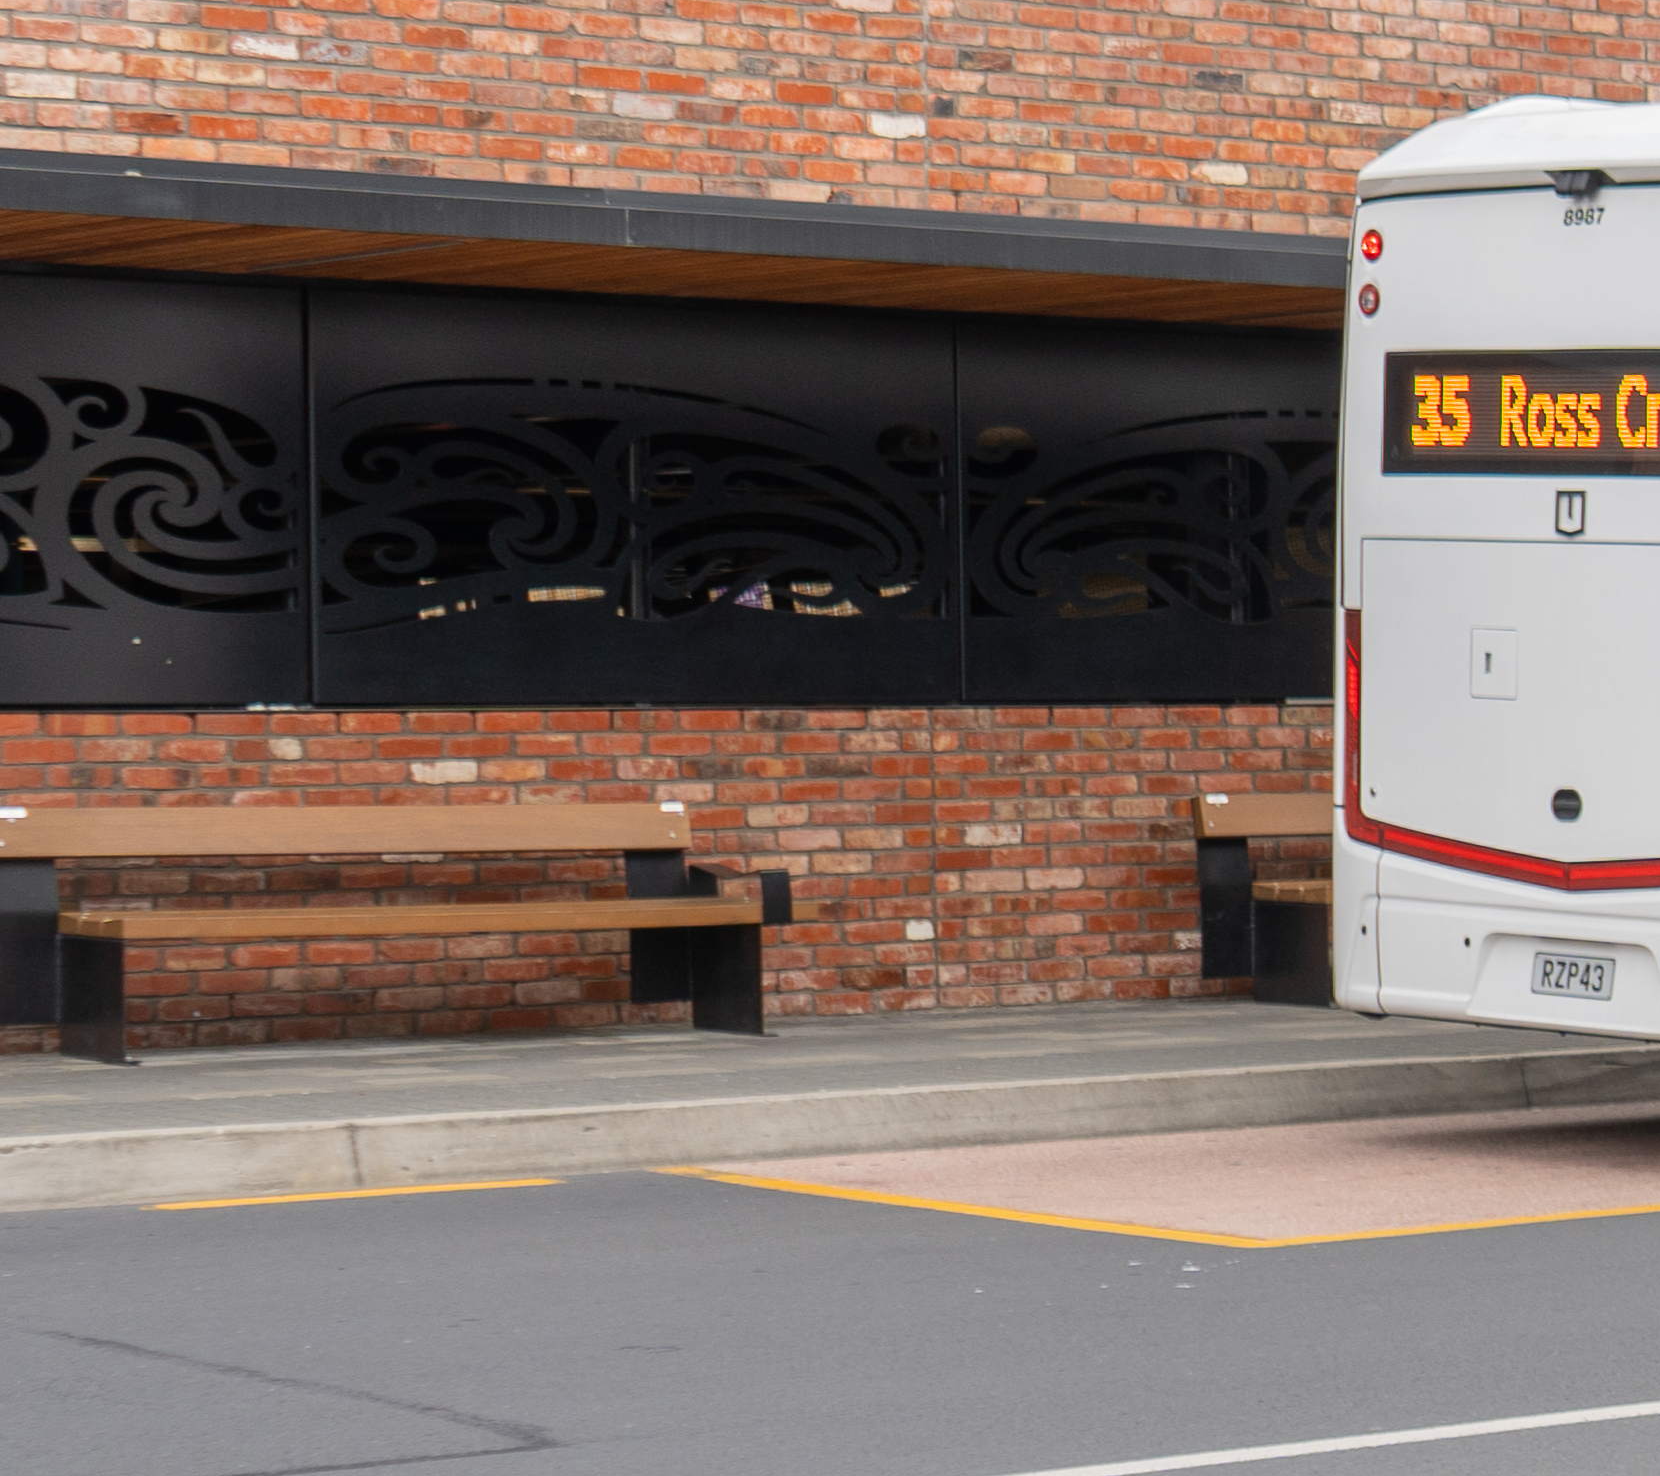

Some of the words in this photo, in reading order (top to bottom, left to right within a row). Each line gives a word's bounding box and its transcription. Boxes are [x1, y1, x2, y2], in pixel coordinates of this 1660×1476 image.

[1563, 208, 1605, 226] 8987
[1411, 375, 1471, 447] 35
[1501, 375, 1601, 448] Ross
[1541, 959, 1605, 992] RZP43
